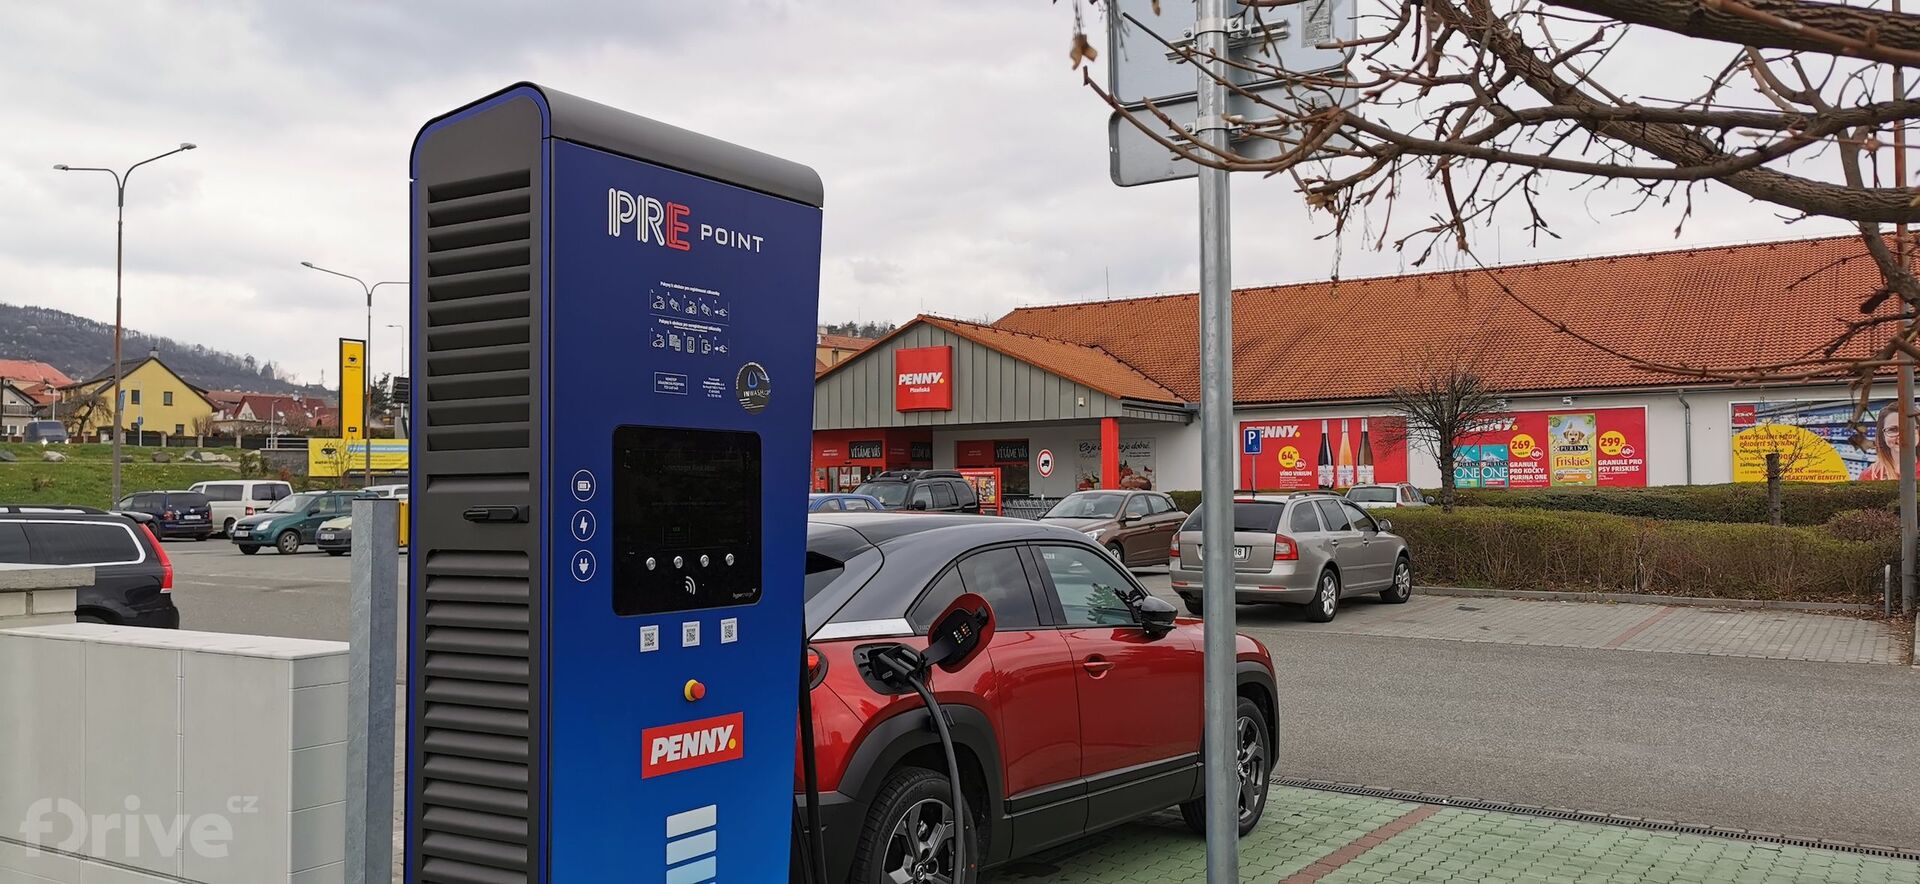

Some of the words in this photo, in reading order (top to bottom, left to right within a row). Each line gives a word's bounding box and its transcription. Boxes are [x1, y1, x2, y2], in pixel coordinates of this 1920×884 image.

[609, 187, 690, 251] PRE
[700, 223, 764, 253] POINT
[1248, 431, 1256, 445] P
[1556, 456, 1590, 466] Friskies
[1454, 466, 1480, 478] ONE
[1482, 466, 1508, 478] ONE
[650, 725, 736, 765] PENNY.
